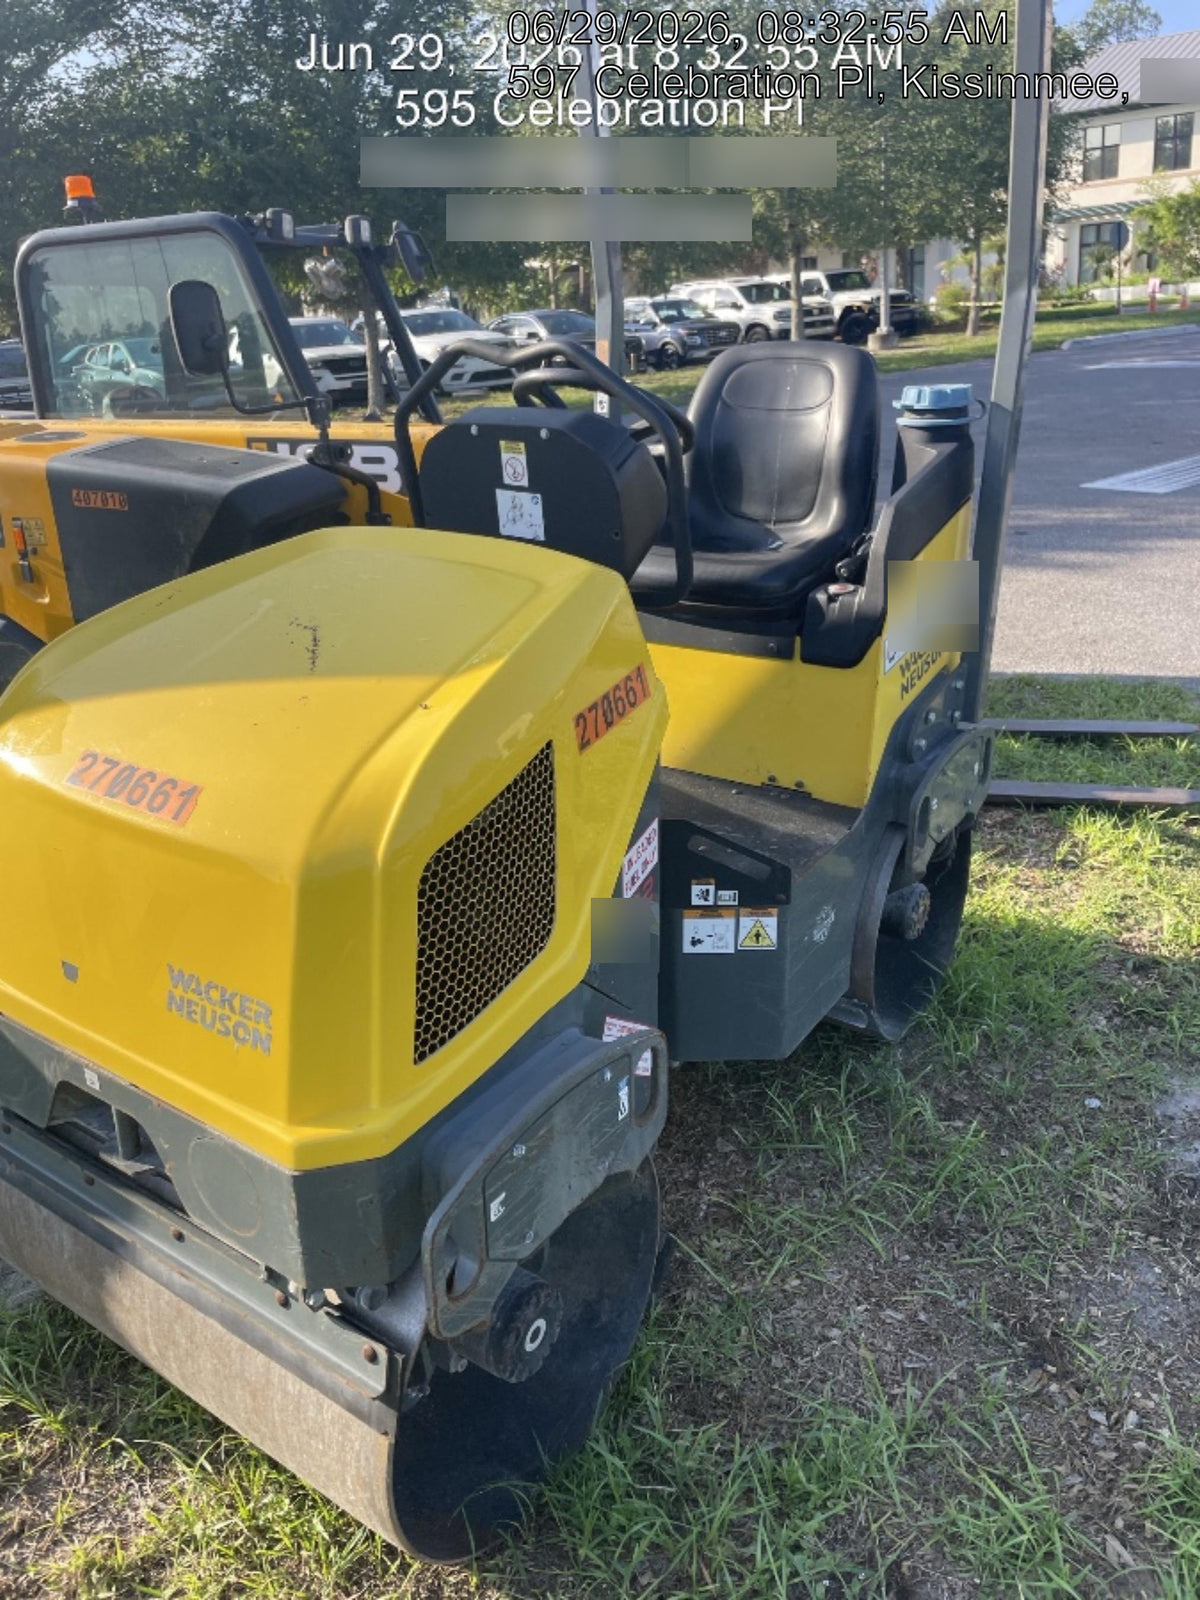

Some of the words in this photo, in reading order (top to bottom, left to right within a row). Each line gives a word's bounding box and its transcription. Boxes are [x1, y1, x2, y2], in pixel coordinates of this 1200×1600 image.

[66, 752, 199, 821] 270661
[166, 963, 273, 1030] WACKER
[167, 989, 273, 1057] NEUSON
